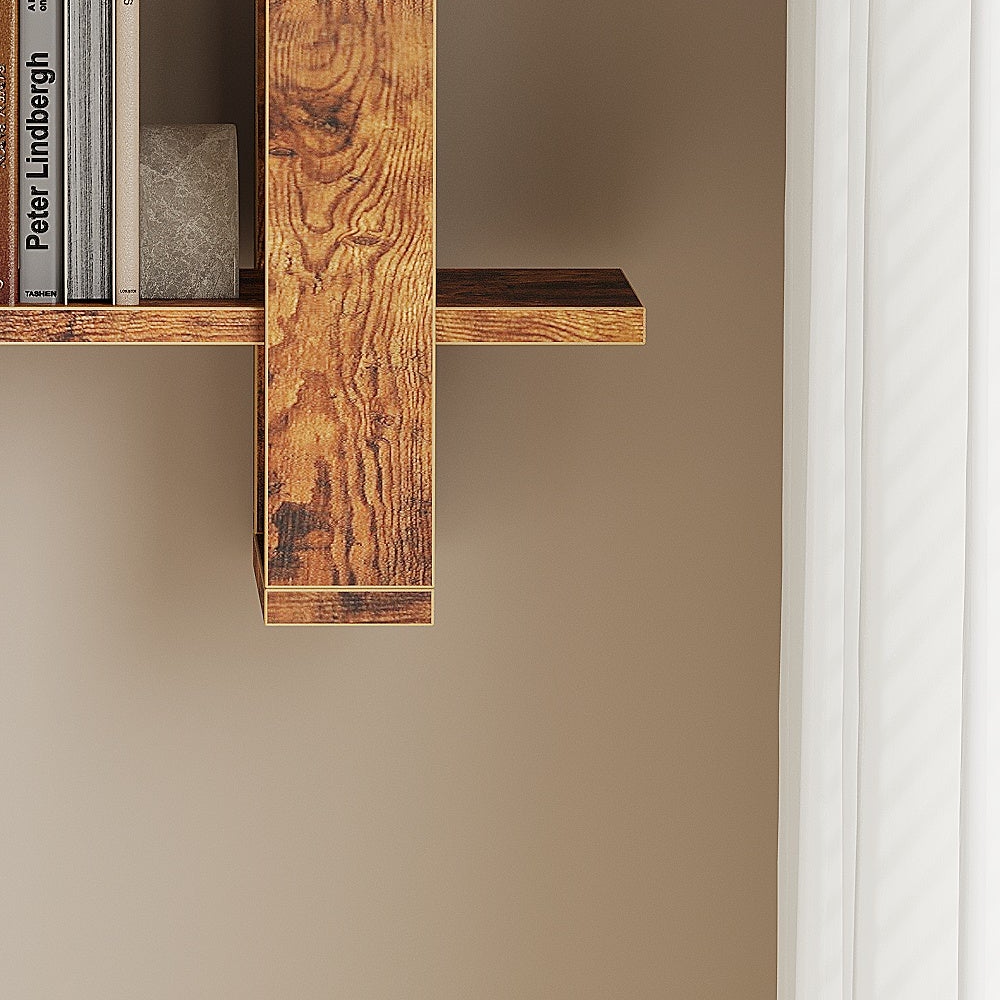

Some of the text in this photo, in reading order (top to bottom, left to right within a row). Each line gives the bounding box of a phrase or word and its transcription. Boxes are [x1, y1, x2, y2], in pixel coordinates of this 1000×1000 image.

[28, 3, 36, 12] A
[39, 0, 48, 12] on
[26, 51, 56, 250] Peter Lindbergh
